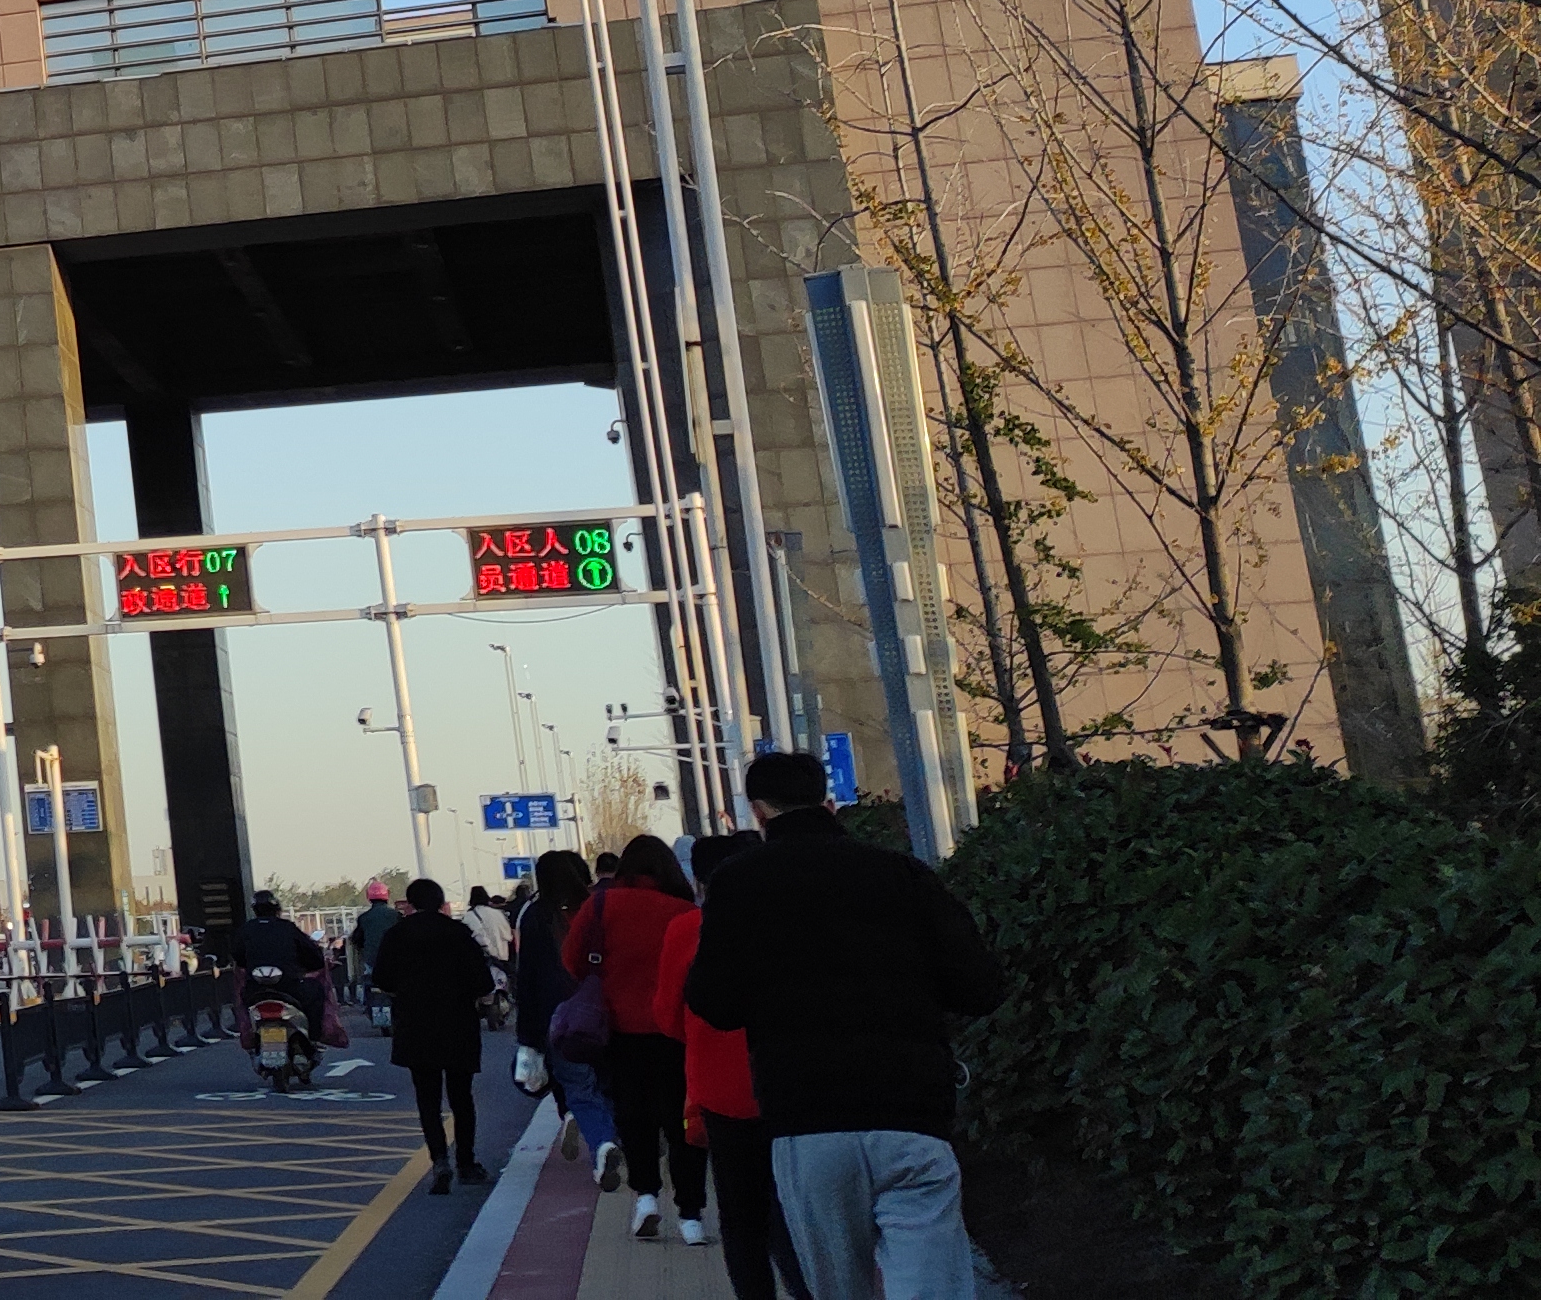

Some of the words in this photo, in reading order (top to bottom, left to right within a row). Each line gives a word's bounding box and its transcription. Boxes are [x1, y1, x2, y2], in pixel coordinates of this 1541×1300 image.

[474, 527, 569, 559] 入区人
[574, 528, 611, 555] 08
[118, 547, 203, 580] 入区行
[204, 548, 237, 574] 07
[478, 560, 570, 593] 员通道
[120, 583, 211, 616] 政通道
